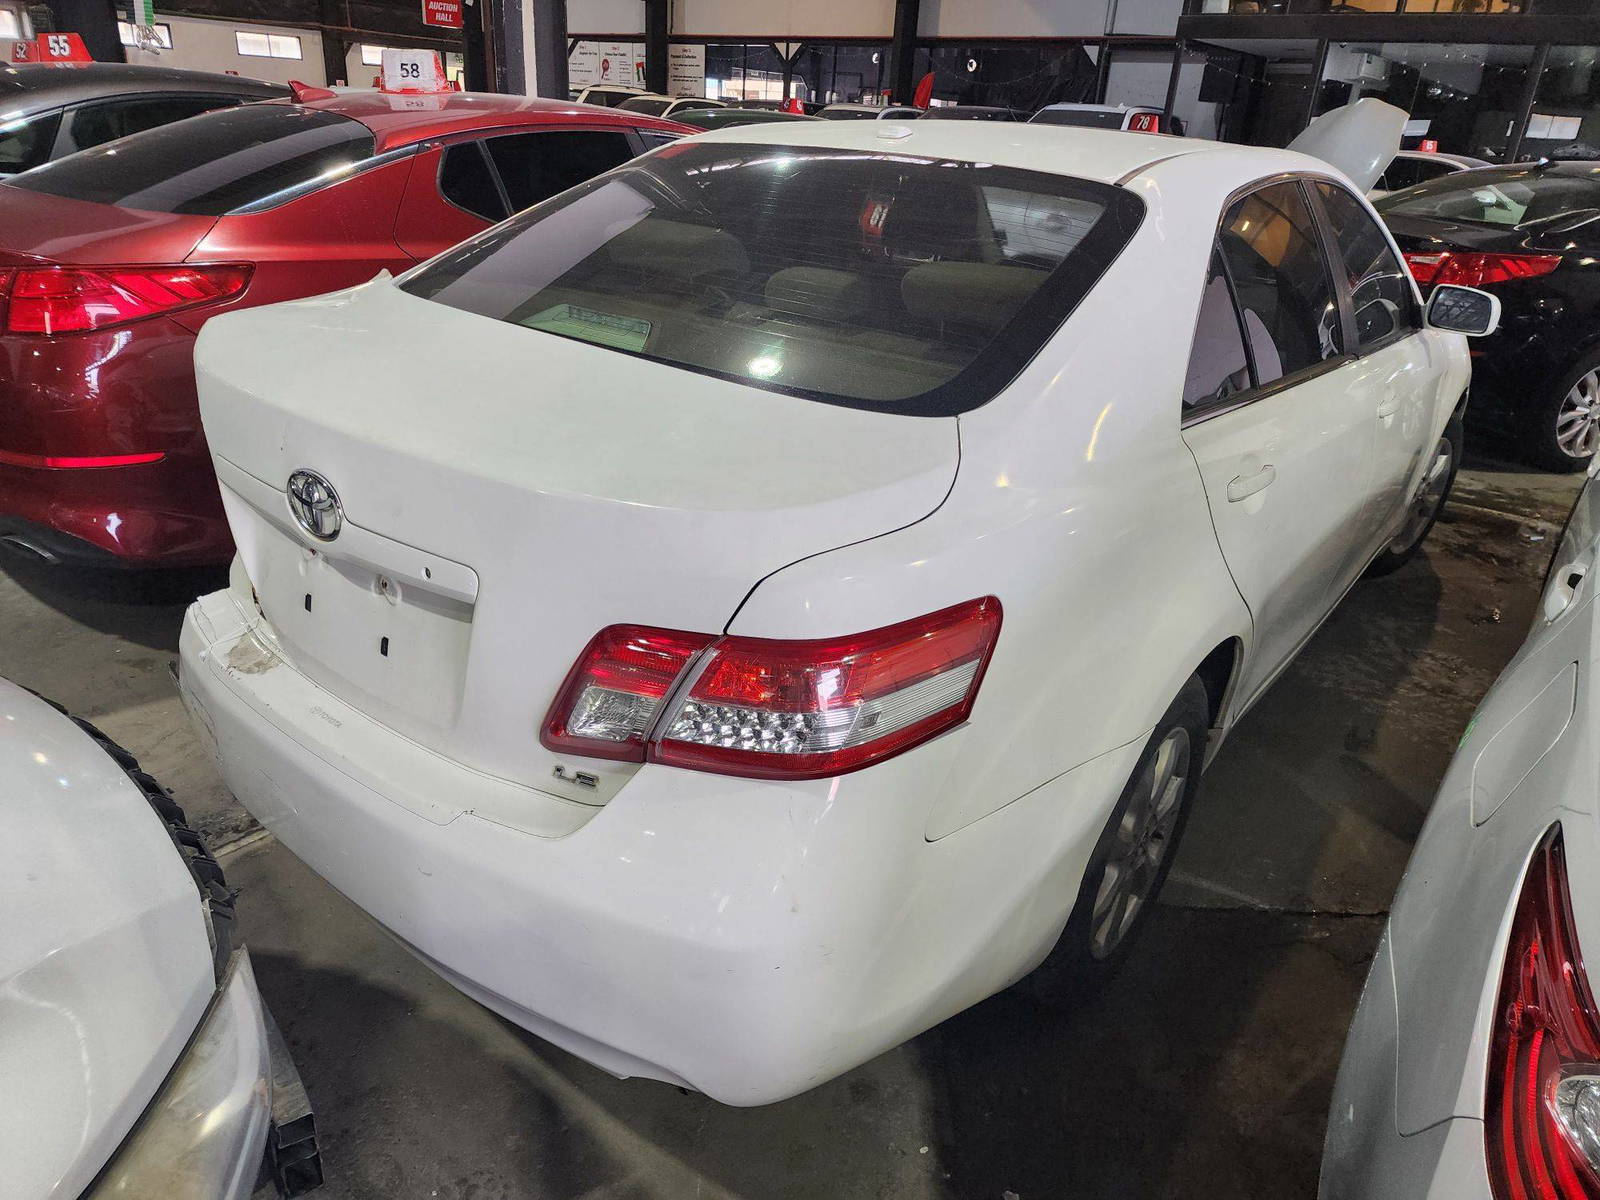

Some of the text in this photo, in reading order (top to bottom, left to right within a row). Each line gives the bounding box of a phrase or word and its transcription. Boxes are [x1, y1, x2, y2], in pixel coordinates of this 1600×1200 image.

[428, 2, 458, 13] AUCTION
[435, 12, 453, 22] HALL
[15, 43, 28, 60] 52
[48, 35, 71, 57] 55
[400, 62, 420, 78] 58
[1137, 115, 1150, 130] 78
[552, 765, 600, 787] LE
